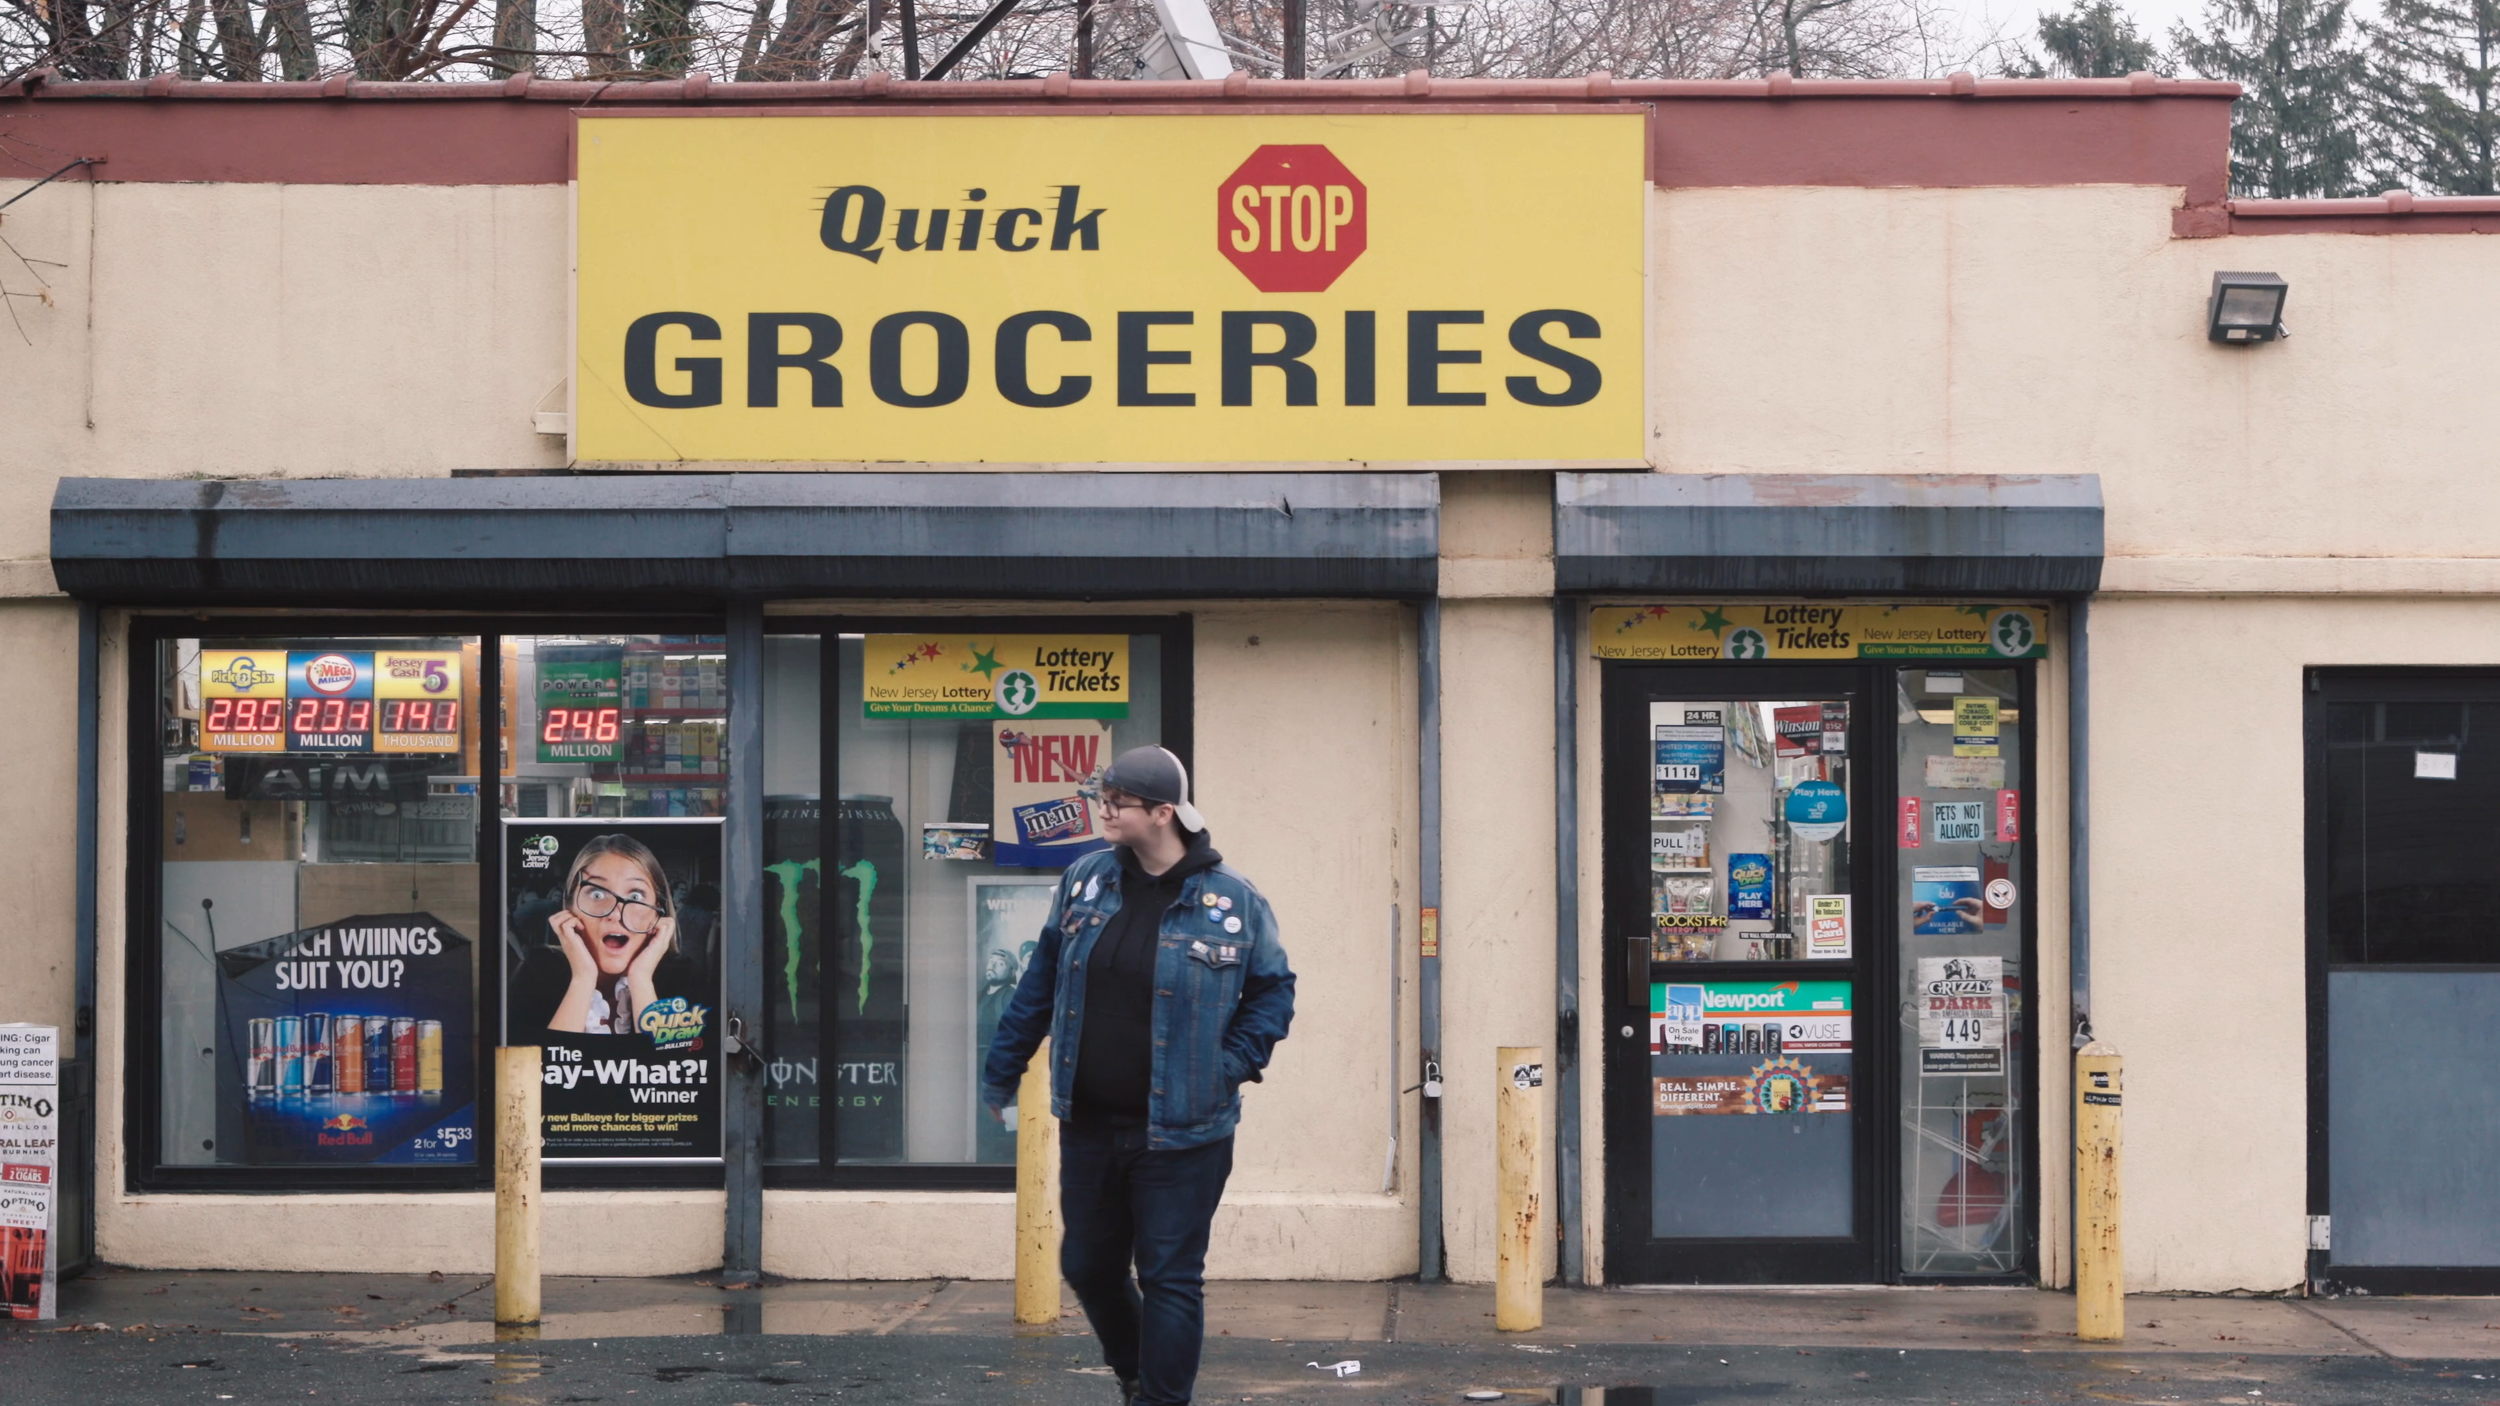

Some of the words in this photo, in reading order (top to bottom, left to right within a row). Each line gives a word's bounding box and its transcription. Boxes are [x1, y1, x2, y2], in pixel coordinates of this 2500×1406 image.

[812, 184, 1107, 264] Quick
[1230, 184, 1353, 253] STOP
[623, 309, 1603, 409] GROCERIES
[1764, 605, 1843, 631] Lottery
[1775, 627, 1850, 650] Tickets
[1864, 628, 1892, 641] New
[1897, 628, 1933, 643] Jersey
[1937, 628, 1986, 643] Lottery
[1598, 645, 1627, 657] New
[1631, 645, 1666, 660] Jersey
[1670, 644, 1719, 660] Lottery
[1864, 645, 1885, 657] Give
[1886, 645, 1907, 657] Your
[1908, 645, 1943, 657] Dreams
[1945, 645, 1953, 657] A
[1953, 645, 1988, 657] Chance
[386, 657, 424, 669] Jersey
[1035, 647, 1114, 672] Lottery
[212, 670, 237, 684] Pick
[251, 670, 275, 684] Six
[321, 664, 352, 677] MEGA
[391, 667, 421, 678] Cash
[422, 660, 450, 693] 5
[543, 681, 602, 690] POWER
[1047, 670, 1121, 692] Tickets
[870, 686, 899, 698] New
[902, 686, 938, 700] Jersey
[942, 686, 991, 700] Lottery
[870, 703, 890, 713] Give
[892, 703, 912, 713] Your
[914, 703, 948, 713] Dreams
[950, 703, 957, 713] A
[959, 703, 992, 713] Chance
[396, 701, 457, 731] 141
[1686, 711, 1700, 720] 24
[1701, 711, 1719, 720] HR.
[544, 709, 619, 742] 246
[1775, 720, 1820, 734] Winston
[213, 734, 276, 746] MILLION
[300, 734, 362, 747] MILLION
[383, 734, 454, 747] THOUSAND
[551, 744, 613, 757] MILLION
[1013, 735, 1099, 783] NEW
[259, 763, 390, 790] ATM
[1794, 788, 1815, 798] Play
[1817, 788, 1841, 796] Here
[1935, 805, 1956, 821] PETS
[1963, 804, 1982, 820] NOT
[1940, 823, 1980, 839] ALLOWED
[1653, 838, 1684, 849] PULL
[526, 854, 550, 862] Jersey
[522, 861, 550, 869] Lottery
[1732, 867, 1767, 881] Quick
[1738, 892, 1763, 900] PLAY
[1940, 887, 1955, 899] blu
[1738, 900, 1763, 908] HERE
[1818, 920, 1839, 930] We
[1814, 927, 1844, 939] Card
[339, 926, 443, 957] WIIINGS
[275, 961, 331, 990] SUIT
[336, 959, 405, 989] YOU?
[1928, 980, 1993, 997] GRIZZLY
[1702, 990, 1785, 1011] Newport
[1929, 997, 1993, 1010] DARK
[1942, 1010, 1969, 1018] AMERICAN
[1971, 1010, 1993, 1018] TOBACCO
[640, 1005, 712, 1037] Quick
[654, 1023, 704, 1044] Draw
[1668, 1026, 1680, 1034] On
[1682, 1026, 1699, 1034] Sale
[1803, 1024, 1841, 1039] VUSE
[0, 1033, 22, 1043] ING:
[24, 1033, 51, 1044] Cigar
[664, 1039, 694, 1050] BULLSEYE
[1674, 1034, 1693, 1042] Here
[0, 1046, 20, 1056] king
[23, 1047, 41, 1055] can
[548, 1046, 583, 1062] The
[0, 1060, 18, 1068] ung
[21, 1059, 54, 1067] cancer
[0, 1070, 11, 1079] art
[13, 1070, 54, 1079] disease.
[541, 1059, 708, 1089] ay-What?!
[763, 1057, 898, 1089] ONTER
[1660, 1082, 1692, 1092] REAL.
[1696, 1082, 1740, 1091] SIMPLE.
[630, 1088, 698, 1103] Winner
[767, 1095, 883, 1107] ENERGY
[1660, 1092, 1723, 1103] DIFFERENT.
[0, 1094, 54, 1118] TIMO
[570, 1113, 613, 1124] Bullseye
[615, 1113, 629, 1122] for
[632, 1113, 665, 1124] bigger
[667, 1113, 698, 1124] prizes
[550, 1123, 570, 1132] and
[572, 1124, 599, 1132] more
[601, 1123, 642, 1132] chances
[644, 1123, 655, 1132] to
[657, 1123, 679, 1132] win!
[0, 1139, 21, 1148] RAL
[24, 1139, 56, 1148] LEAF
[318, 1133, 346, 1146] Red
[347, 1132, 373, 1145] Bull
[414, 1139, 422, 1149] 2
[423, 1138, 437, 1149] for
[9, 1170, 15, 1180] 2
[15, 1171, 42, 1182] CIGARS
[0, 1197, 46, 1212] OPTIMO
[6, 1218, 36, 1226] SWEET
